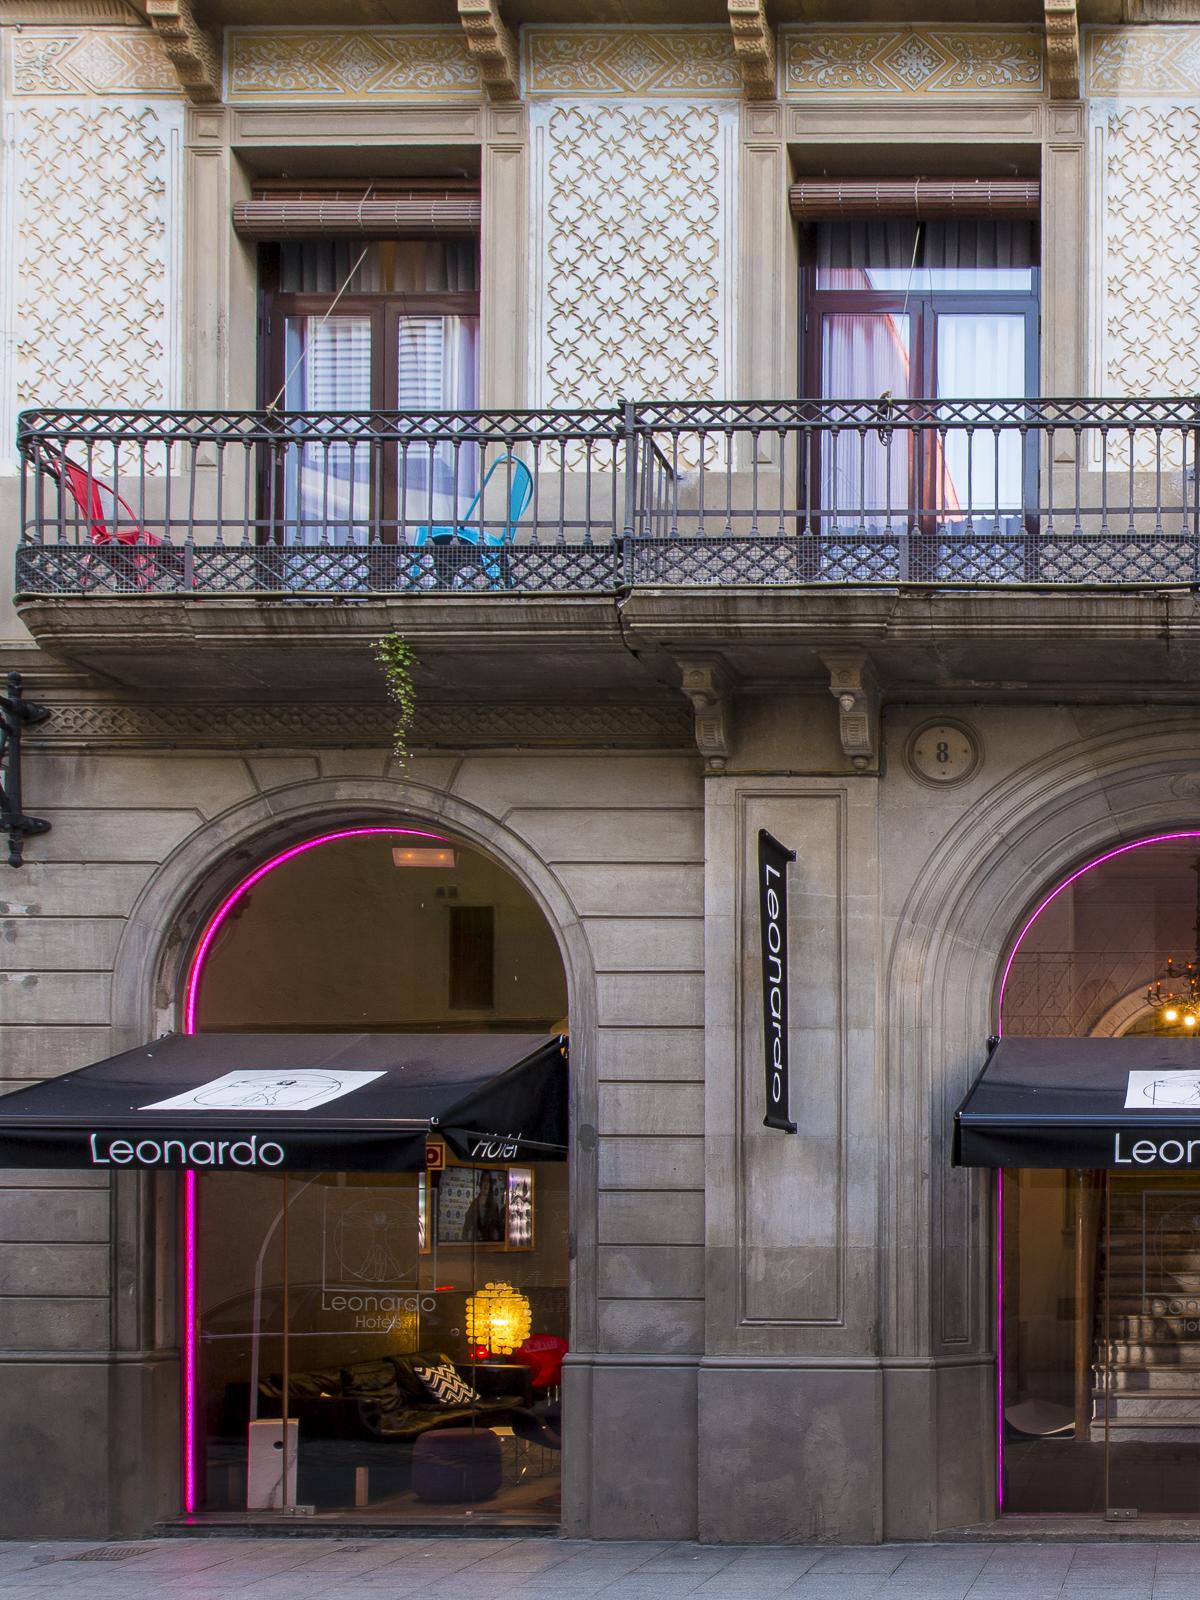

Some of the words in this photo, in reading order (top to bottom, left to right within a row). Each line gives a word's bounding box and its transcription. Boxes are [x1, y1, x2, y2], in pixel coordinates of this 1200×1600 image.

[766, 864, 783, 1103] Leonardo
[90, 1133, 285, 1166] Leonardo
[321, 1292, 437, 1312] Leonardo
[355, 1315, 402, 1329] Hotels
